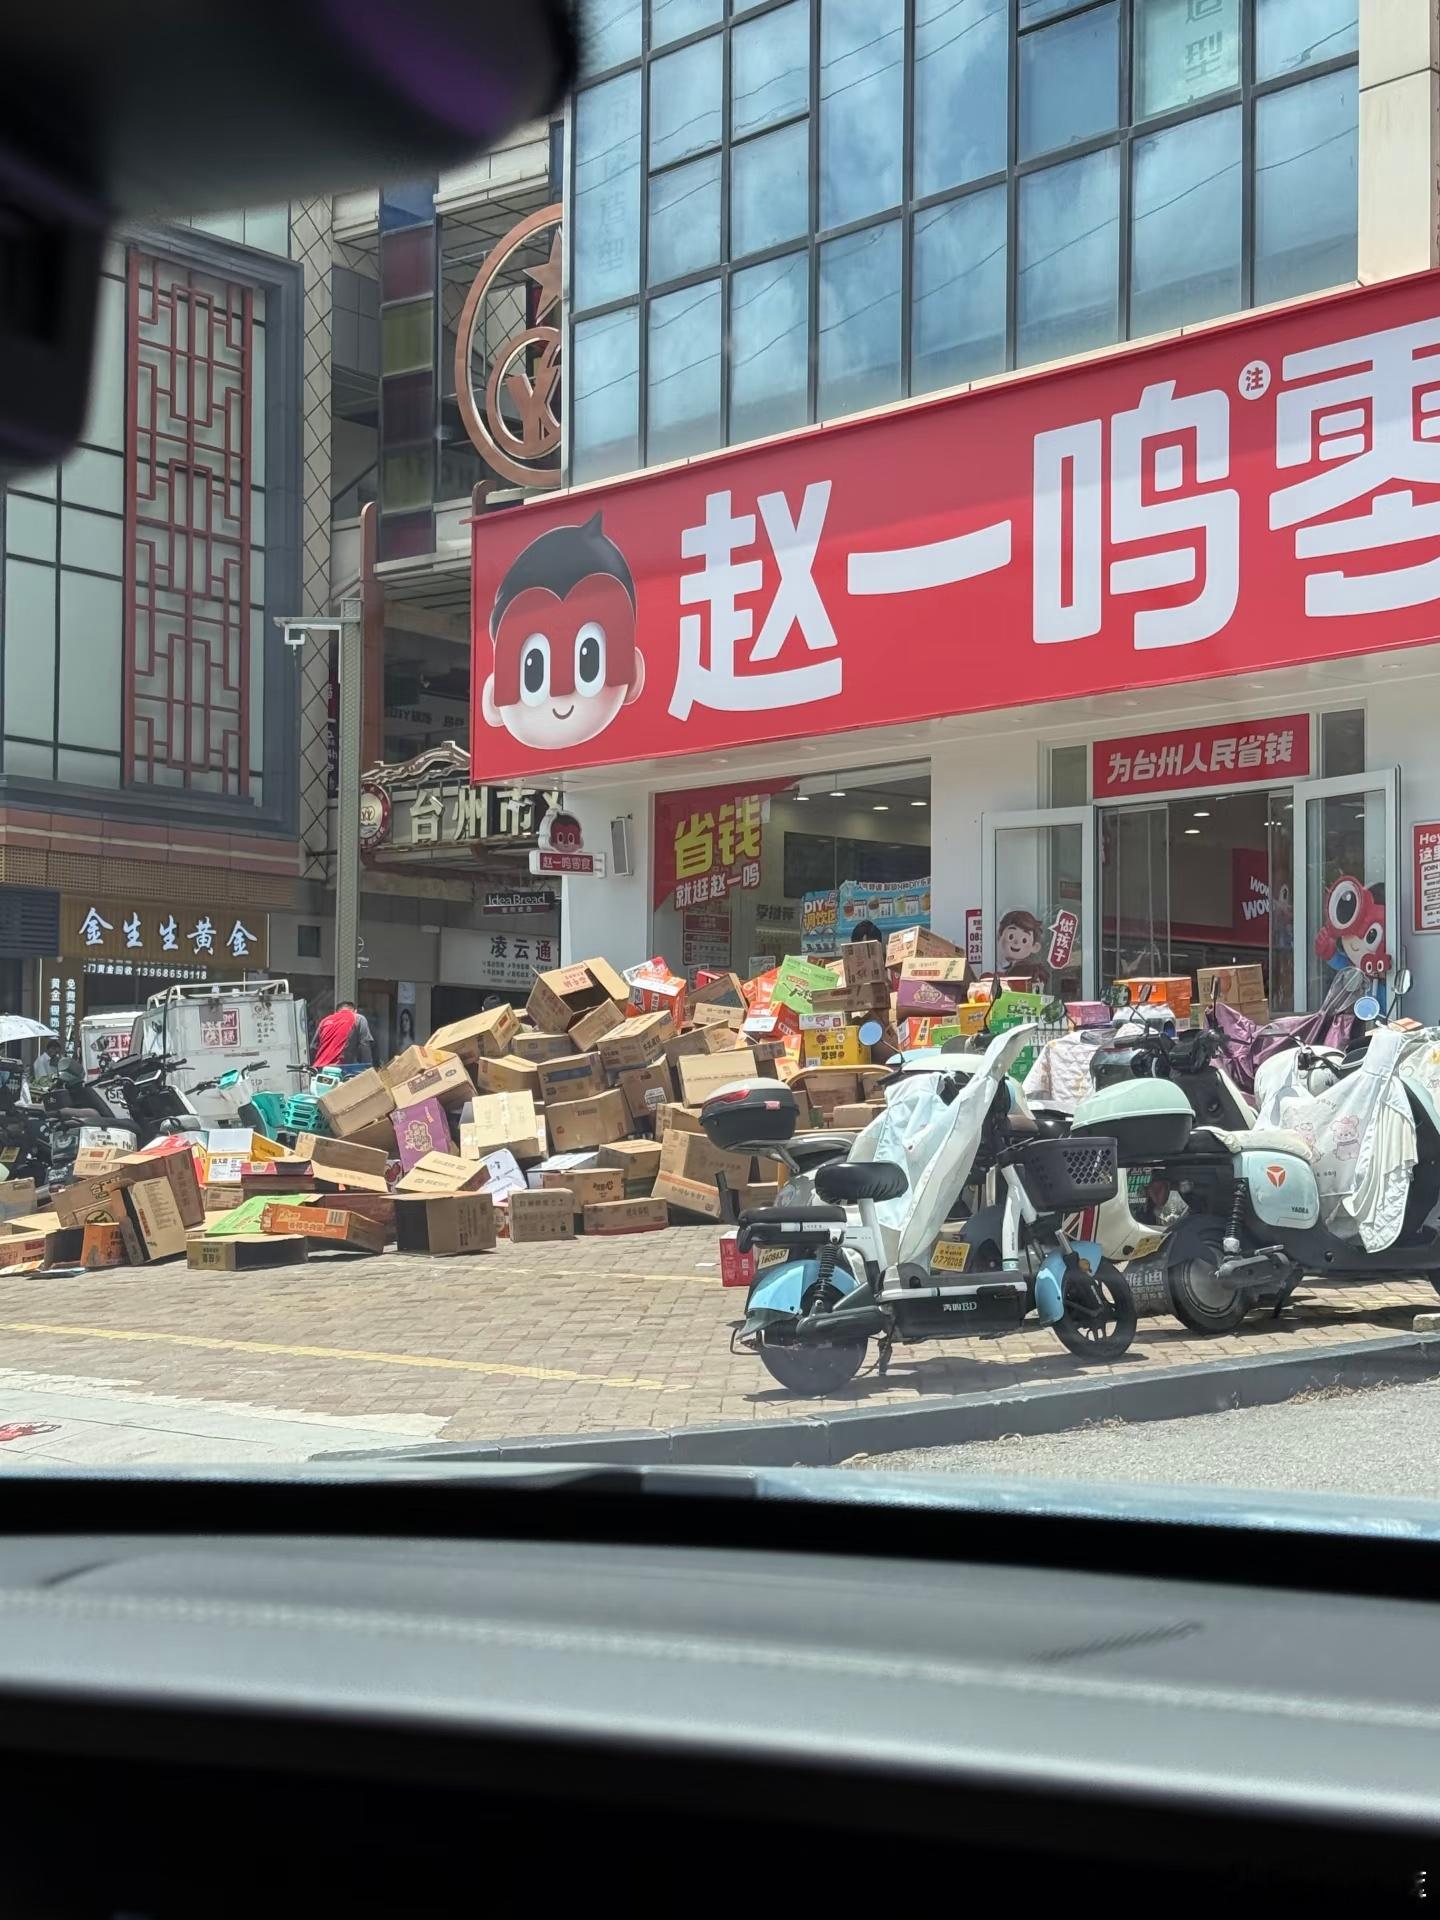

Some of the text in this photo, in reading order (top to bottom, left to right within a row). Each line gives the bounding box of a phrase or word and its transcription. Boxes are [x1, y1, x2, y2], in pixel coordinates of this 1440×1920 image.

[1244, 366, 1266, 392] 注
[1107, 730, 1294, 784] 为台州人民省钱
[410, 784, 566, 843] 台州市
[674, 795, 762, 880] 省钱
[542, 855, 592, 869] 赵一鸣零食
[488, 893, 545, 905] Idea Bread
[675, 861, 760, 910] 就逛赵一鸣
[804, 899, 824, 913] DIY
[79, 907, 257, 957] 金生生黄金
[491, 935, 559, 962] 凌云通
[1053, 917, 1075, 963] 做孩子
[1125, 1270, 1163, 1287] 雅迪
